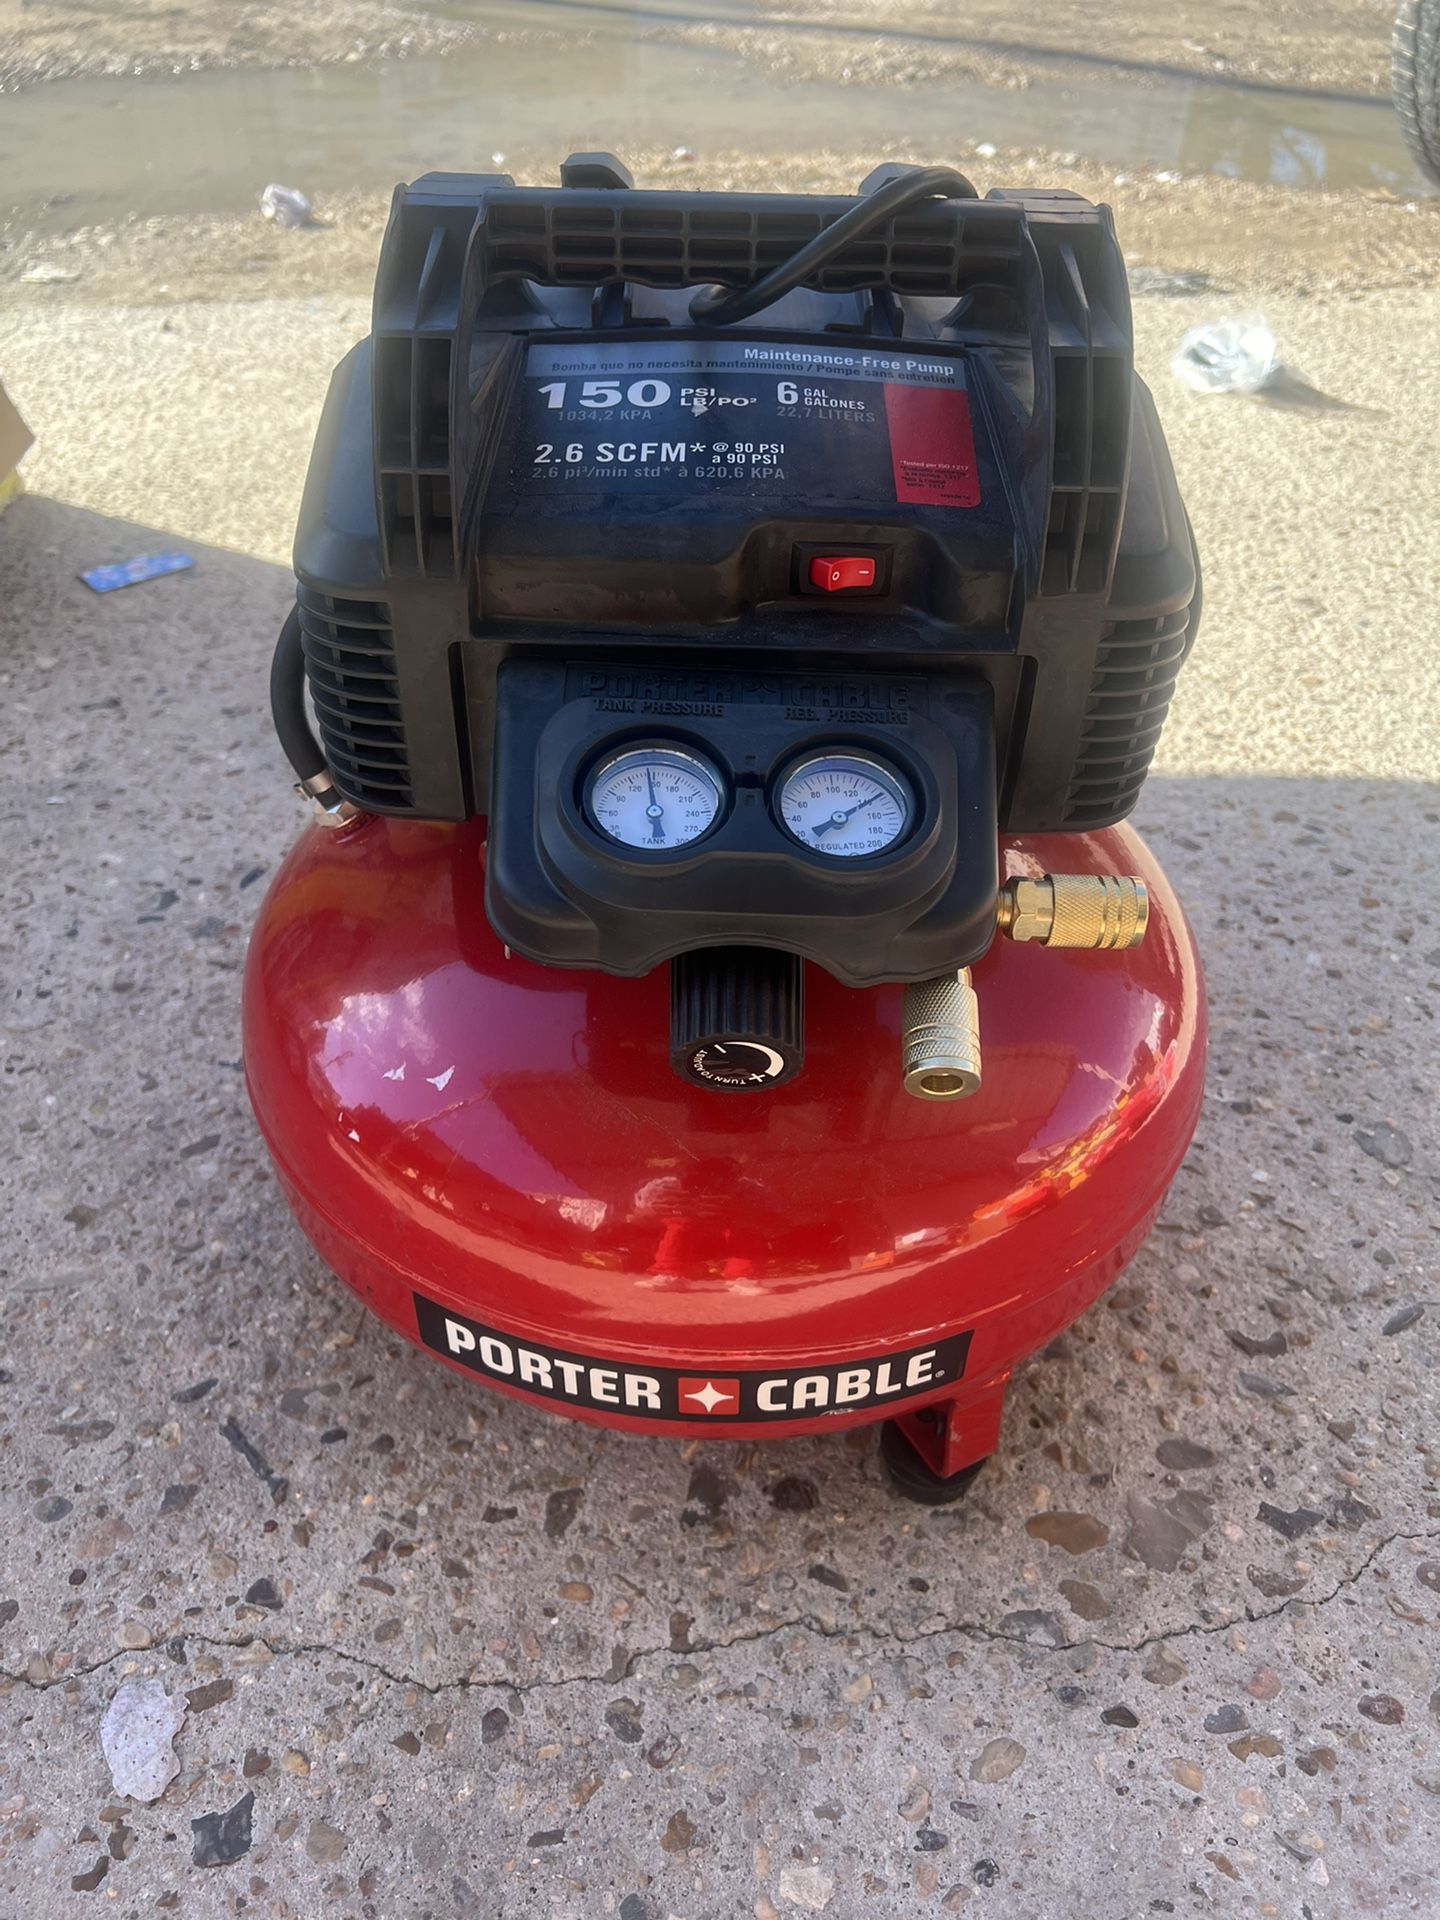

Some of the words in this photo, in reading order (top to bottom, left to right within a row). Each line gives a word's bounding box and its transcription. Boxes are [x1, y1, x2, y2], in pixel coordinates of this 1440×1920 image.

[744, 349, 901, 370] Maintenance-Free
[906, 360, 954, 376] Pump
[552, 362, 597, 372] Bomba
[600, 362, 624, 372] que
[628, 361, 643, 369] no
[647, 360, 702, 369] necesita
[706, 360, 804, 371] mantenimiento
[807, 363, 813, 372] /
[816, 364, 860, 376] Pompe
[864, 369, 894, 379] sans
[898, 373, 955, 385] entretien
[538, 379, 671, 409] 150
[680, 387, 715, 397] PSI
[777, 381, 799, 405] 6
[803, 387, 829, 398] GAL
[804, 397, 865, 410] GALONES
[620, 409, 652, 420] KPA
[818, 408, 875, 422] LITERS
[534, 443, 583, 463] 2.6
[712, 442, 729, 453] @
[735, 442, 753, 453] 90
[760, 443, 784, 454] PSI
[712, 455, 720, 464] a
[727, 453, 745, 464] 90
[752, 454, 777, 465] PSI
[678, 465, 688, 477] à
[751, 467, 785, 479] KPA
[581, 671, 733, 704] PORTER
[791, 682, 911, 710] CABLE
[594, 699, 634, 714] TANK
[640, 701, 724, 717] PRESSURE
[784, 707, 820, 722] REG.
[827, 709, 910, 725] PRESSURE
[811, 791, 821, 799] 80
[798, 801, 808, 809] 60
[685, 810, 700, 818] 240
[867, 812, 882, 820] 160
[868, 827, 883, 835] 180
[815, 842, 865, 851] REGULATED
[867, 839, 883, 848] 200
[701, 1071, 714, 1079] TO
[714, 1076, 747, 1085] TURN
[444, 1317, 661, 1410] PORTER
